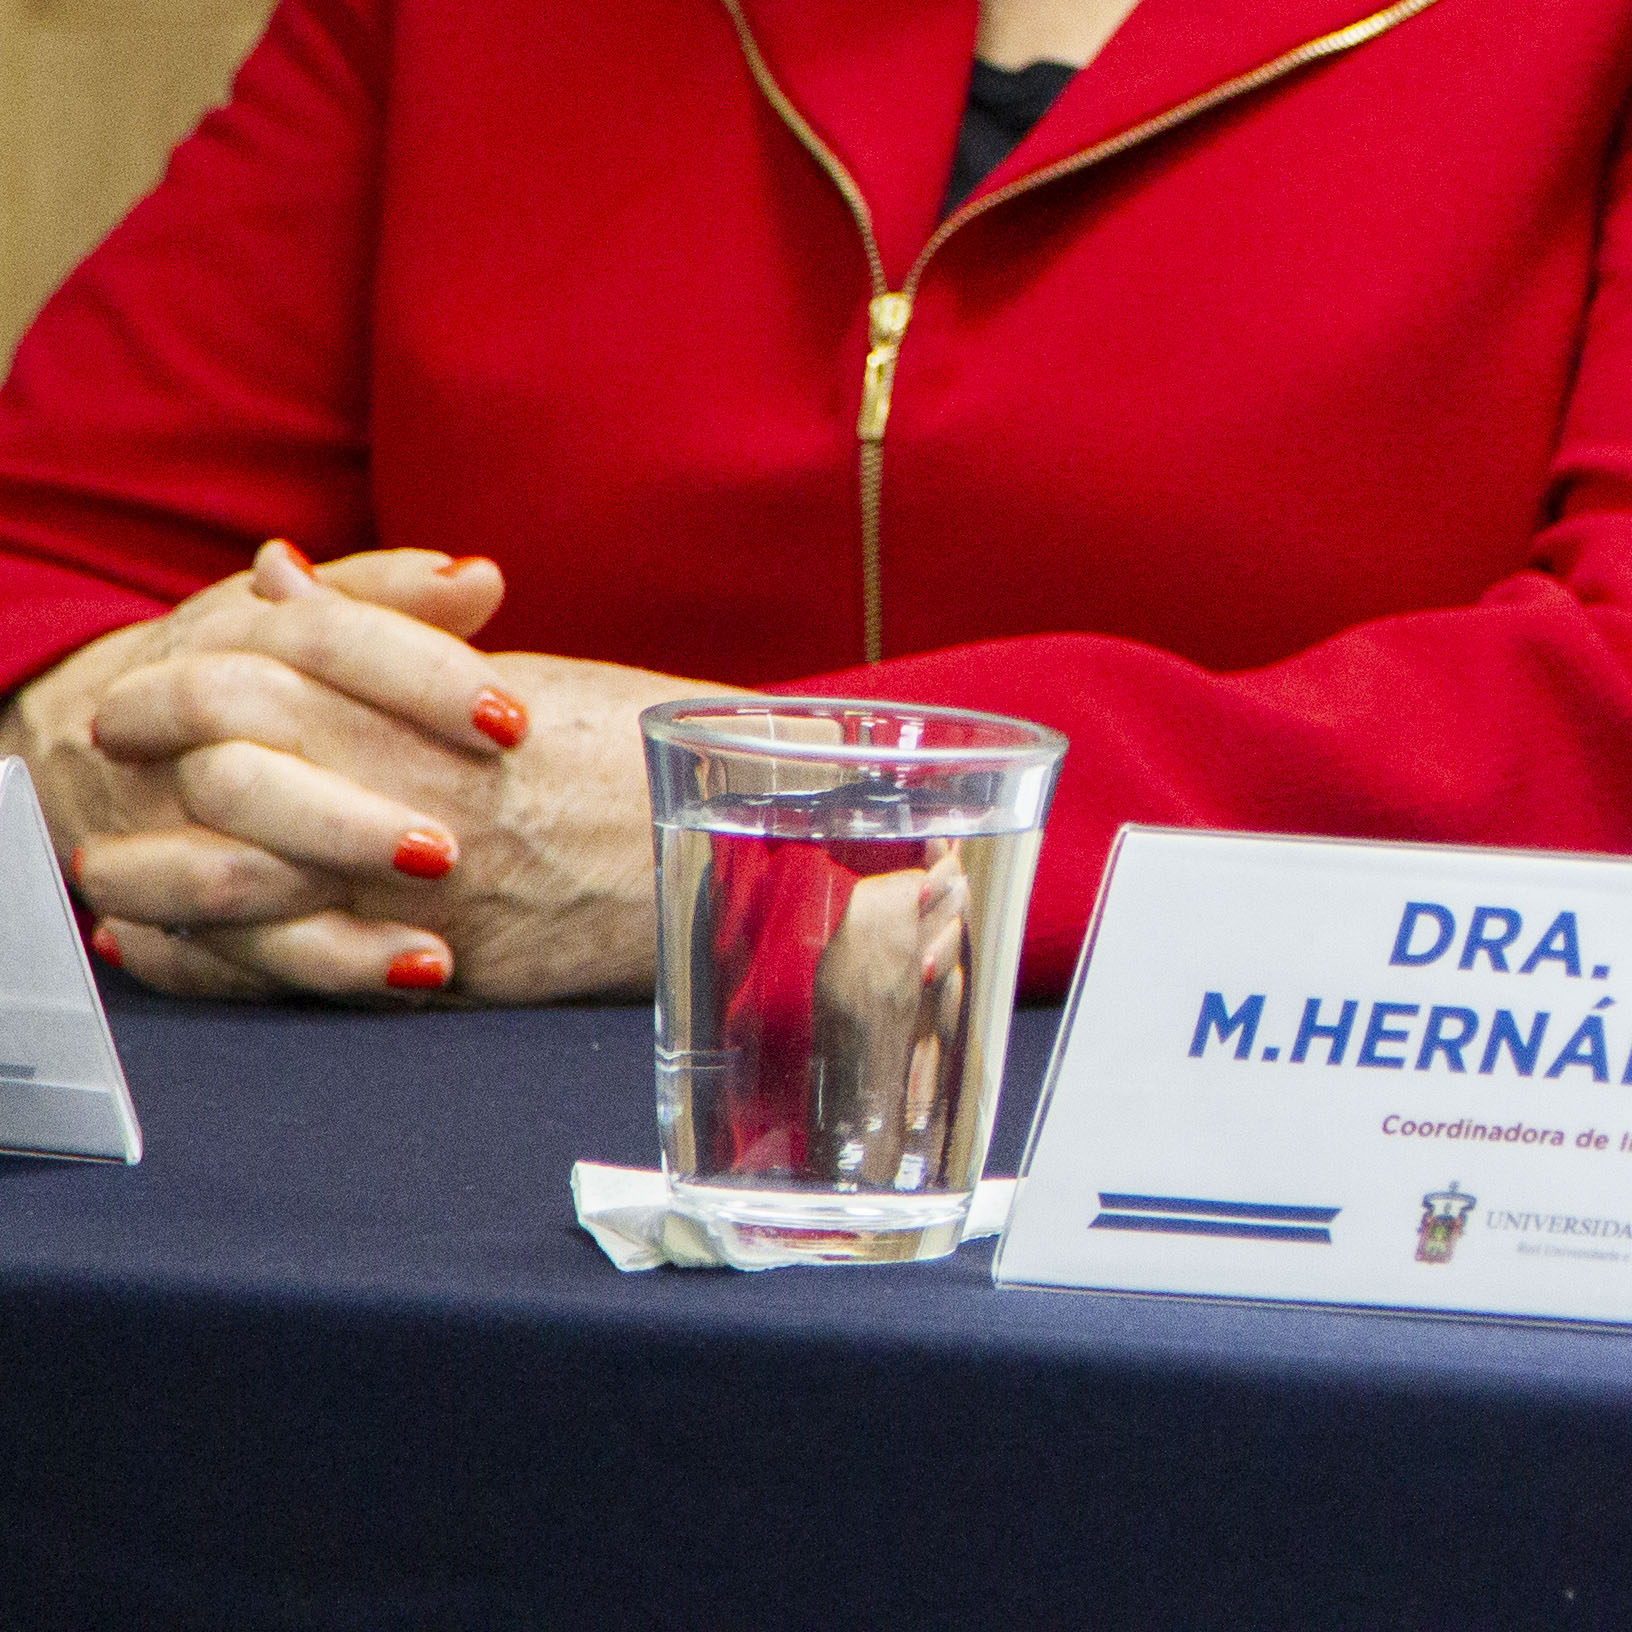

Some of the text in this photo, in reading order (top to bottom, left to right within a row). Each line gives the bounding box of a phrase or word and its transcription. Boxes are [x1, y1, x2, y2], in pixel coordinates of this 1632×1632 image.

[1388, 901, 1611, 980] DRA.
[1381, 1114, 1565, 1146] Coordinadora
[1575, 1128, 1610, 1150] de
